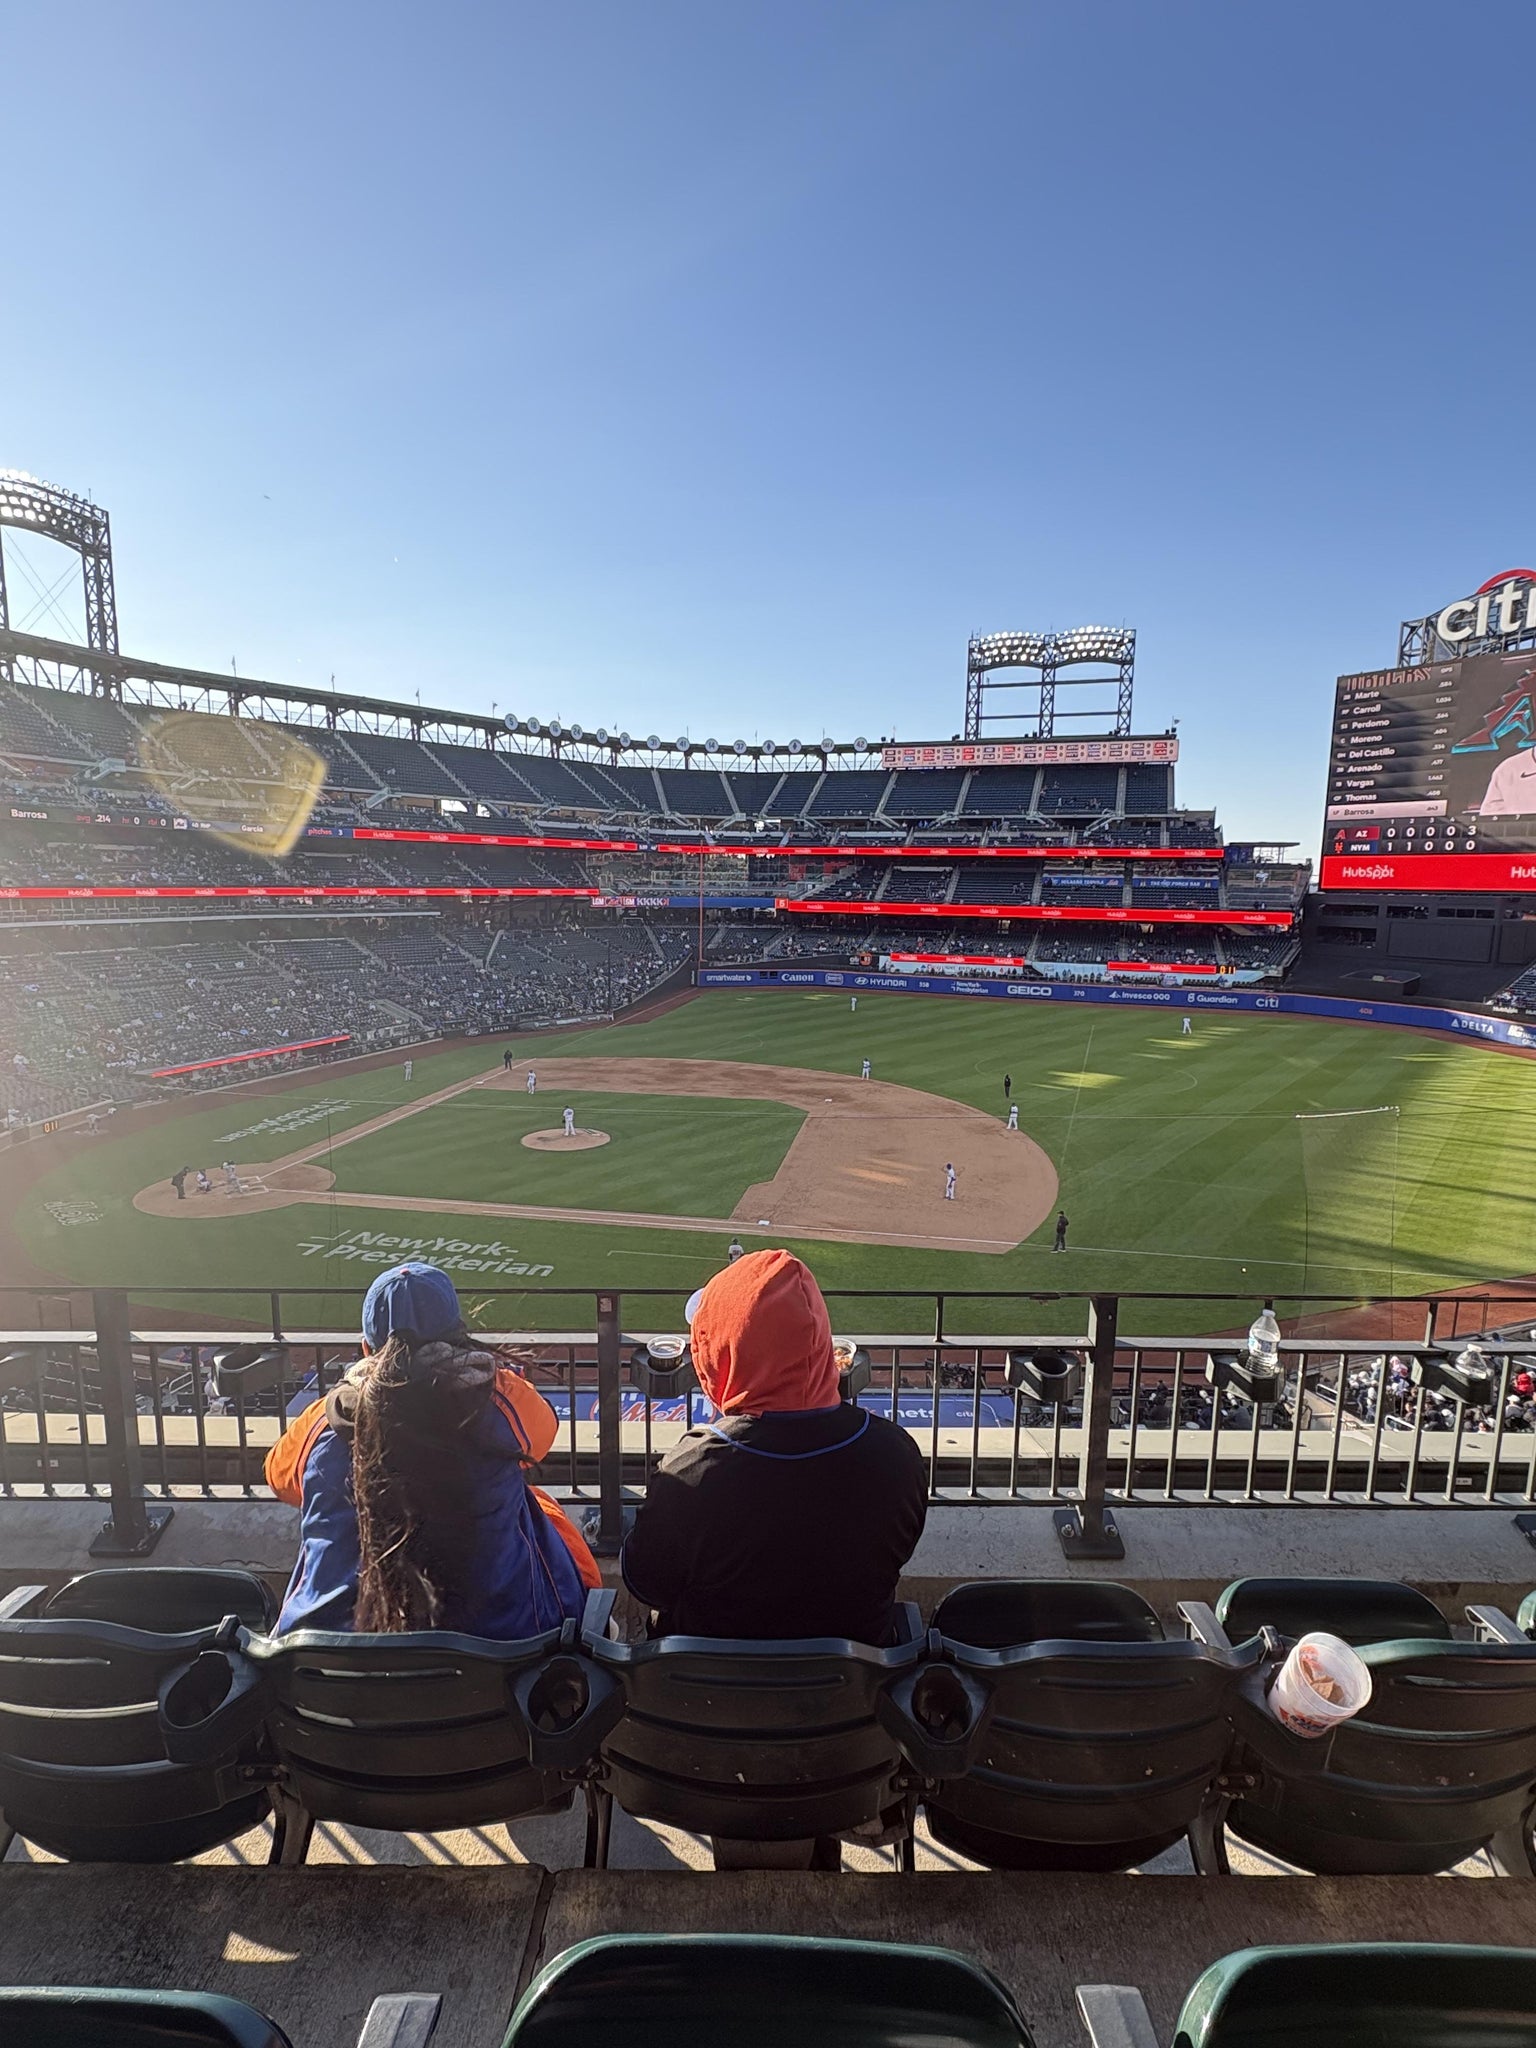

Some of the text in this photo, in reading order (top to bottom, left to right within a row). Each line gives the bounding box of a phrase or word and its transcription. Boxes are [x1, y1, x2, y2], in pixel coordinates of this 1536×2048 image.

[1355, 691, 1379, 700] Marte
[1353, 704, 1381, 714] Carroll
[1352, 719, 1390, 729] Perdomo
[1350, 735, 1382, 744] Moreno
[1349, 750, 1363, 758] Del
[1364, 747, 1395, 757] Castillo
[1347, 763, 1383, 773] Arenado
[1346, 780, 1374, 789] Vargas
[1345, 793, 1376, 802] Thomas
[1344, 808, 1374, 816] Barrosa
[11, 808, 48, 819] Barrosa
[95, 814, 111, 823] .214
[133, 816, 140, 825] 0
[160, 818, 166, 827] 0
[241, 824, 264, 833] Garcia
[307, 828, 333, 836] pitches
[1355, 825, 1477, 838] AZ 0 0 0 0 3
[1350, 840, 1475, 852] NYM 1 1 0 0 0
[1342, 865, 1394, 879] HubSpot
[706, 974, 745, 982] smartwater
[781, 973, 814, 982] Canon
[870, 978, 907, 987] HYUNDAI
[956, 986, 988, 994] Presbyterian
[1007, 985, 1052, 996] GEICO
[1122, 991, 1152, 999] Invesco
[1197, 993, 1238, 1004] Guardian
[1256, 995, 1279, 1008] citi
[1461, 1019, 1494, 1034] DELTA
[347, 1231, 519, 1256] NewYork-
